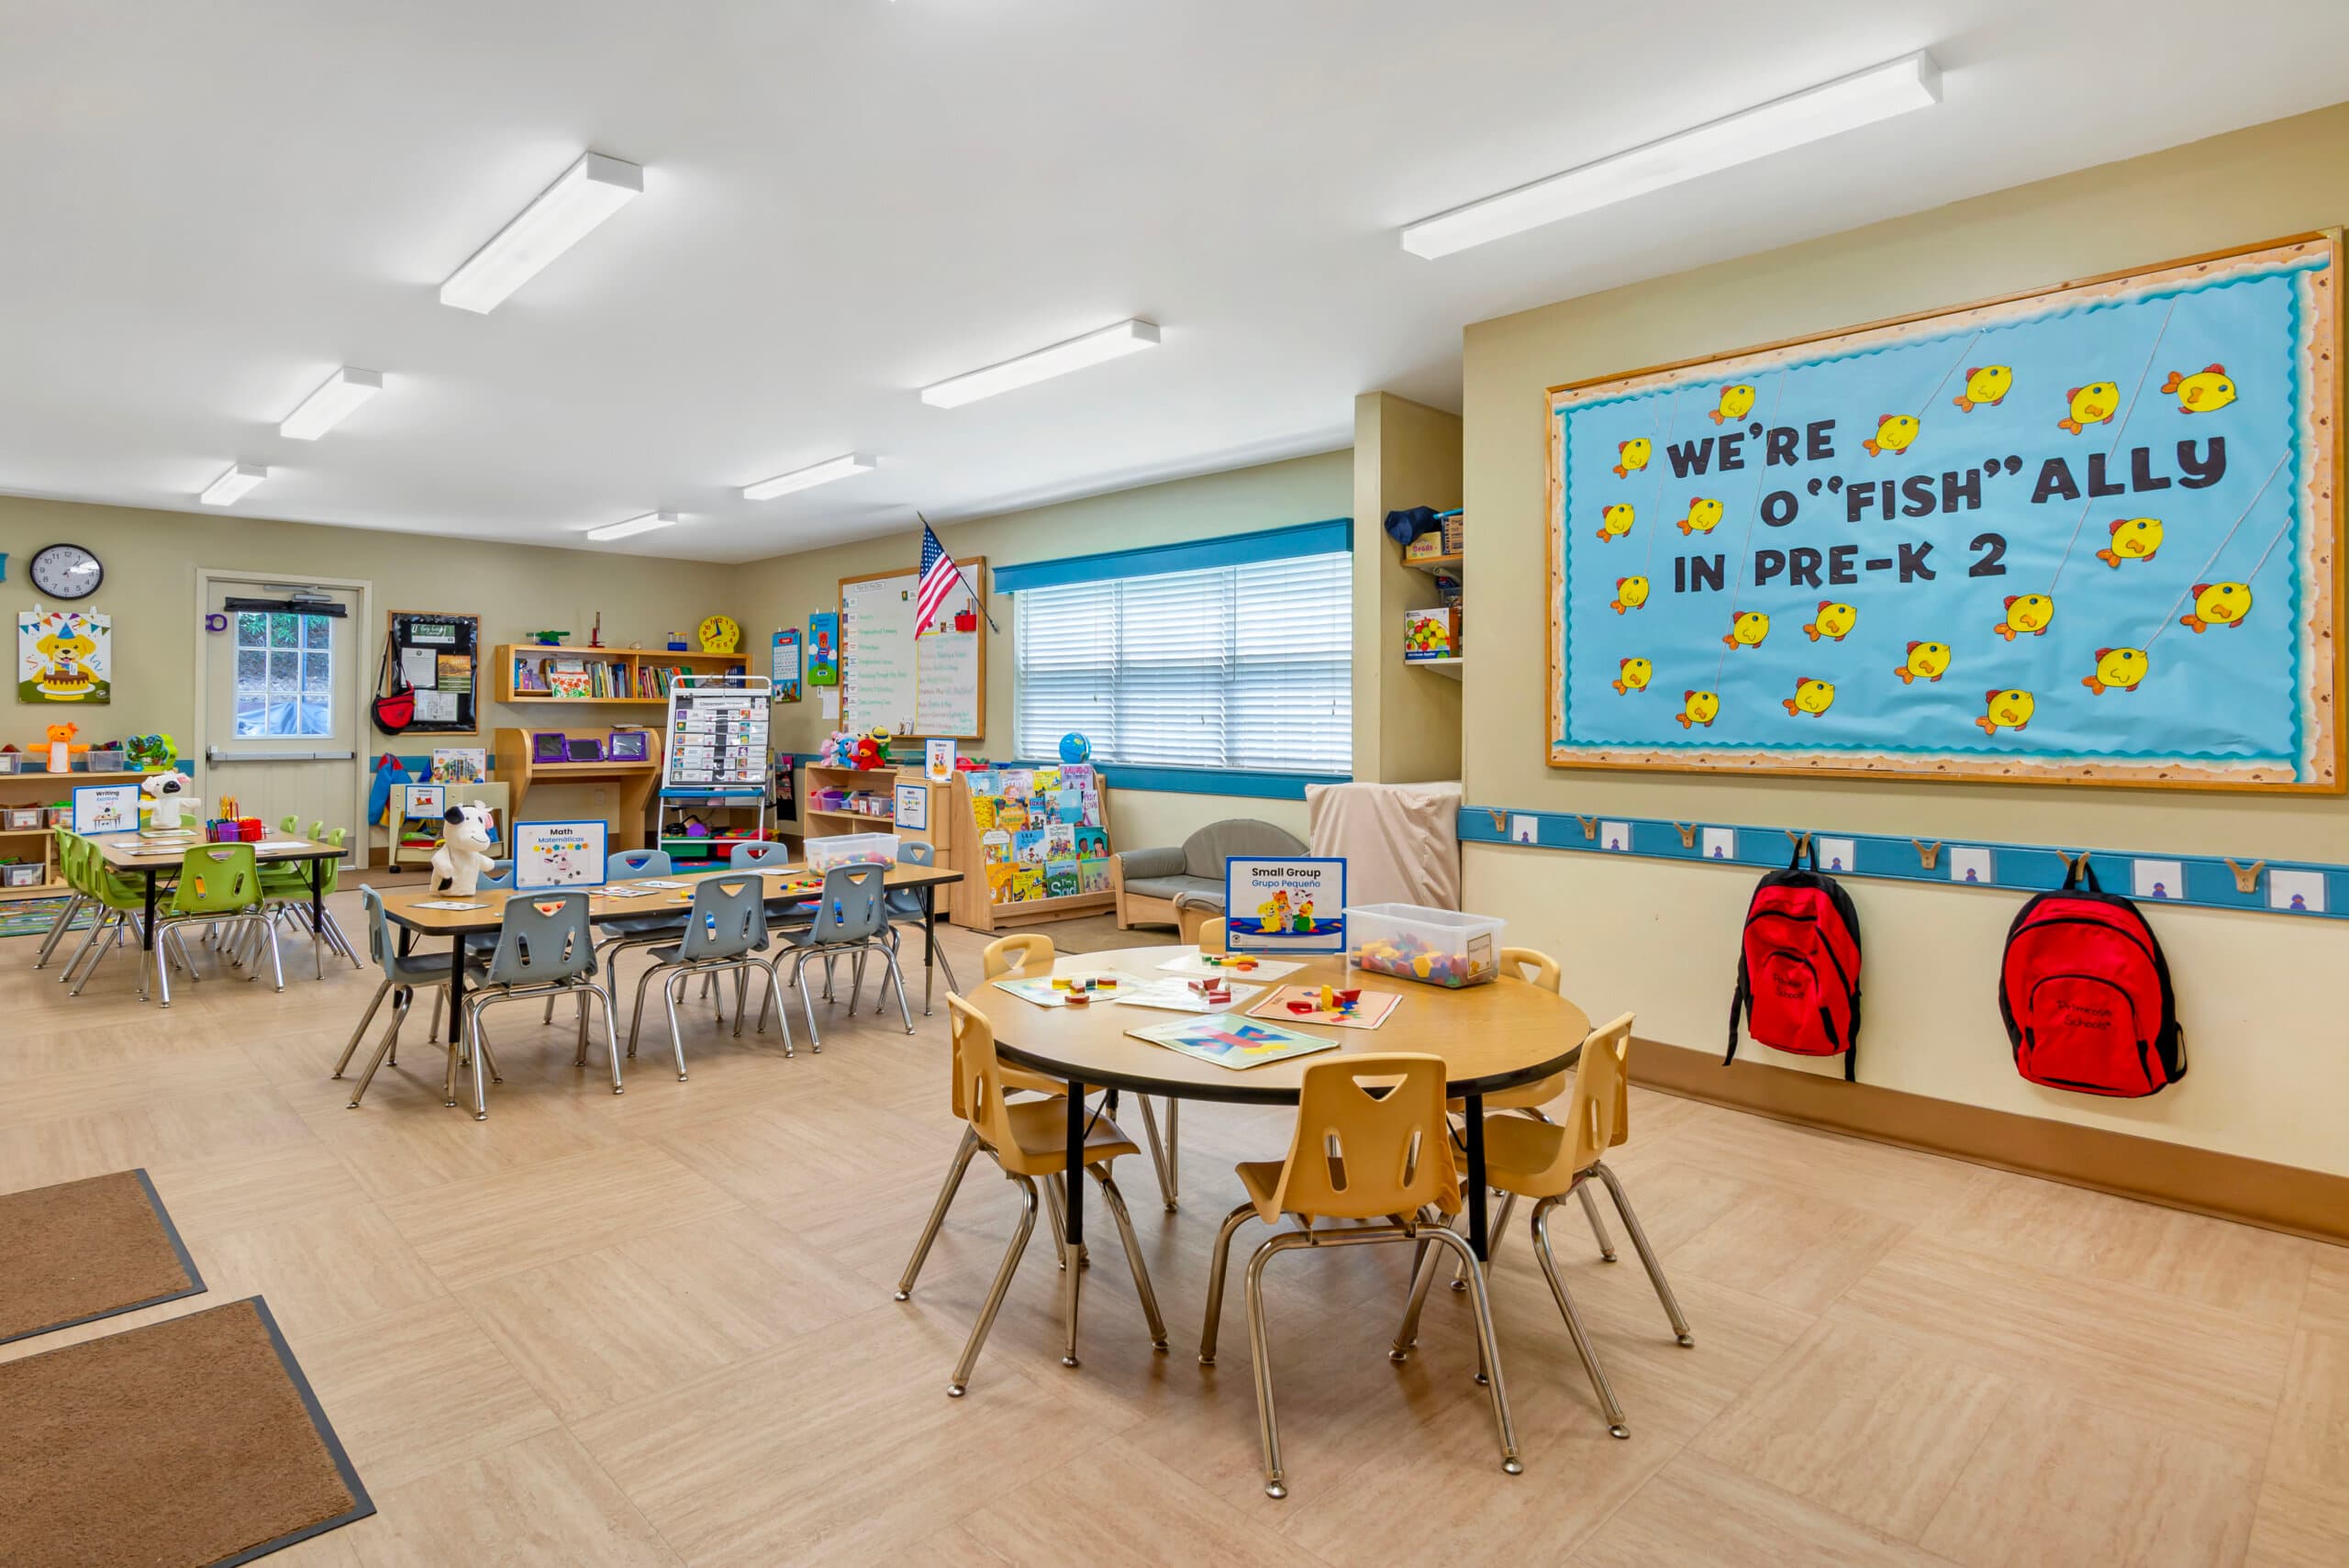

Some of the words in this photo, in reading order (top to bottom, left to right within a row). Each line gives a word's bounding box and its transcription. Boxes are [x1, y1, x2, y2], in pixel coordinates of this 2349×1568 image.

[1666, 419, 1837, 479] WE'RE
[1675, 554, 1726, 593] IN
[1754, 540, 1938, 590] PRE-K
[1968, 532, 2007, 579] 2
[550, 828, 573, 836] Math
[538, 836, 584, 844] Matemáticas
[1252, 867, 1285, 877] Small
[1286, 869, 1321, 880] Group
[1051, 880, 1076, 896] Sad
[1252, 880, 1280, 888] Grupo
[1281, 879, 1321, 888] Pequeño
[2056, 999, 2112, 1017] Primrose
